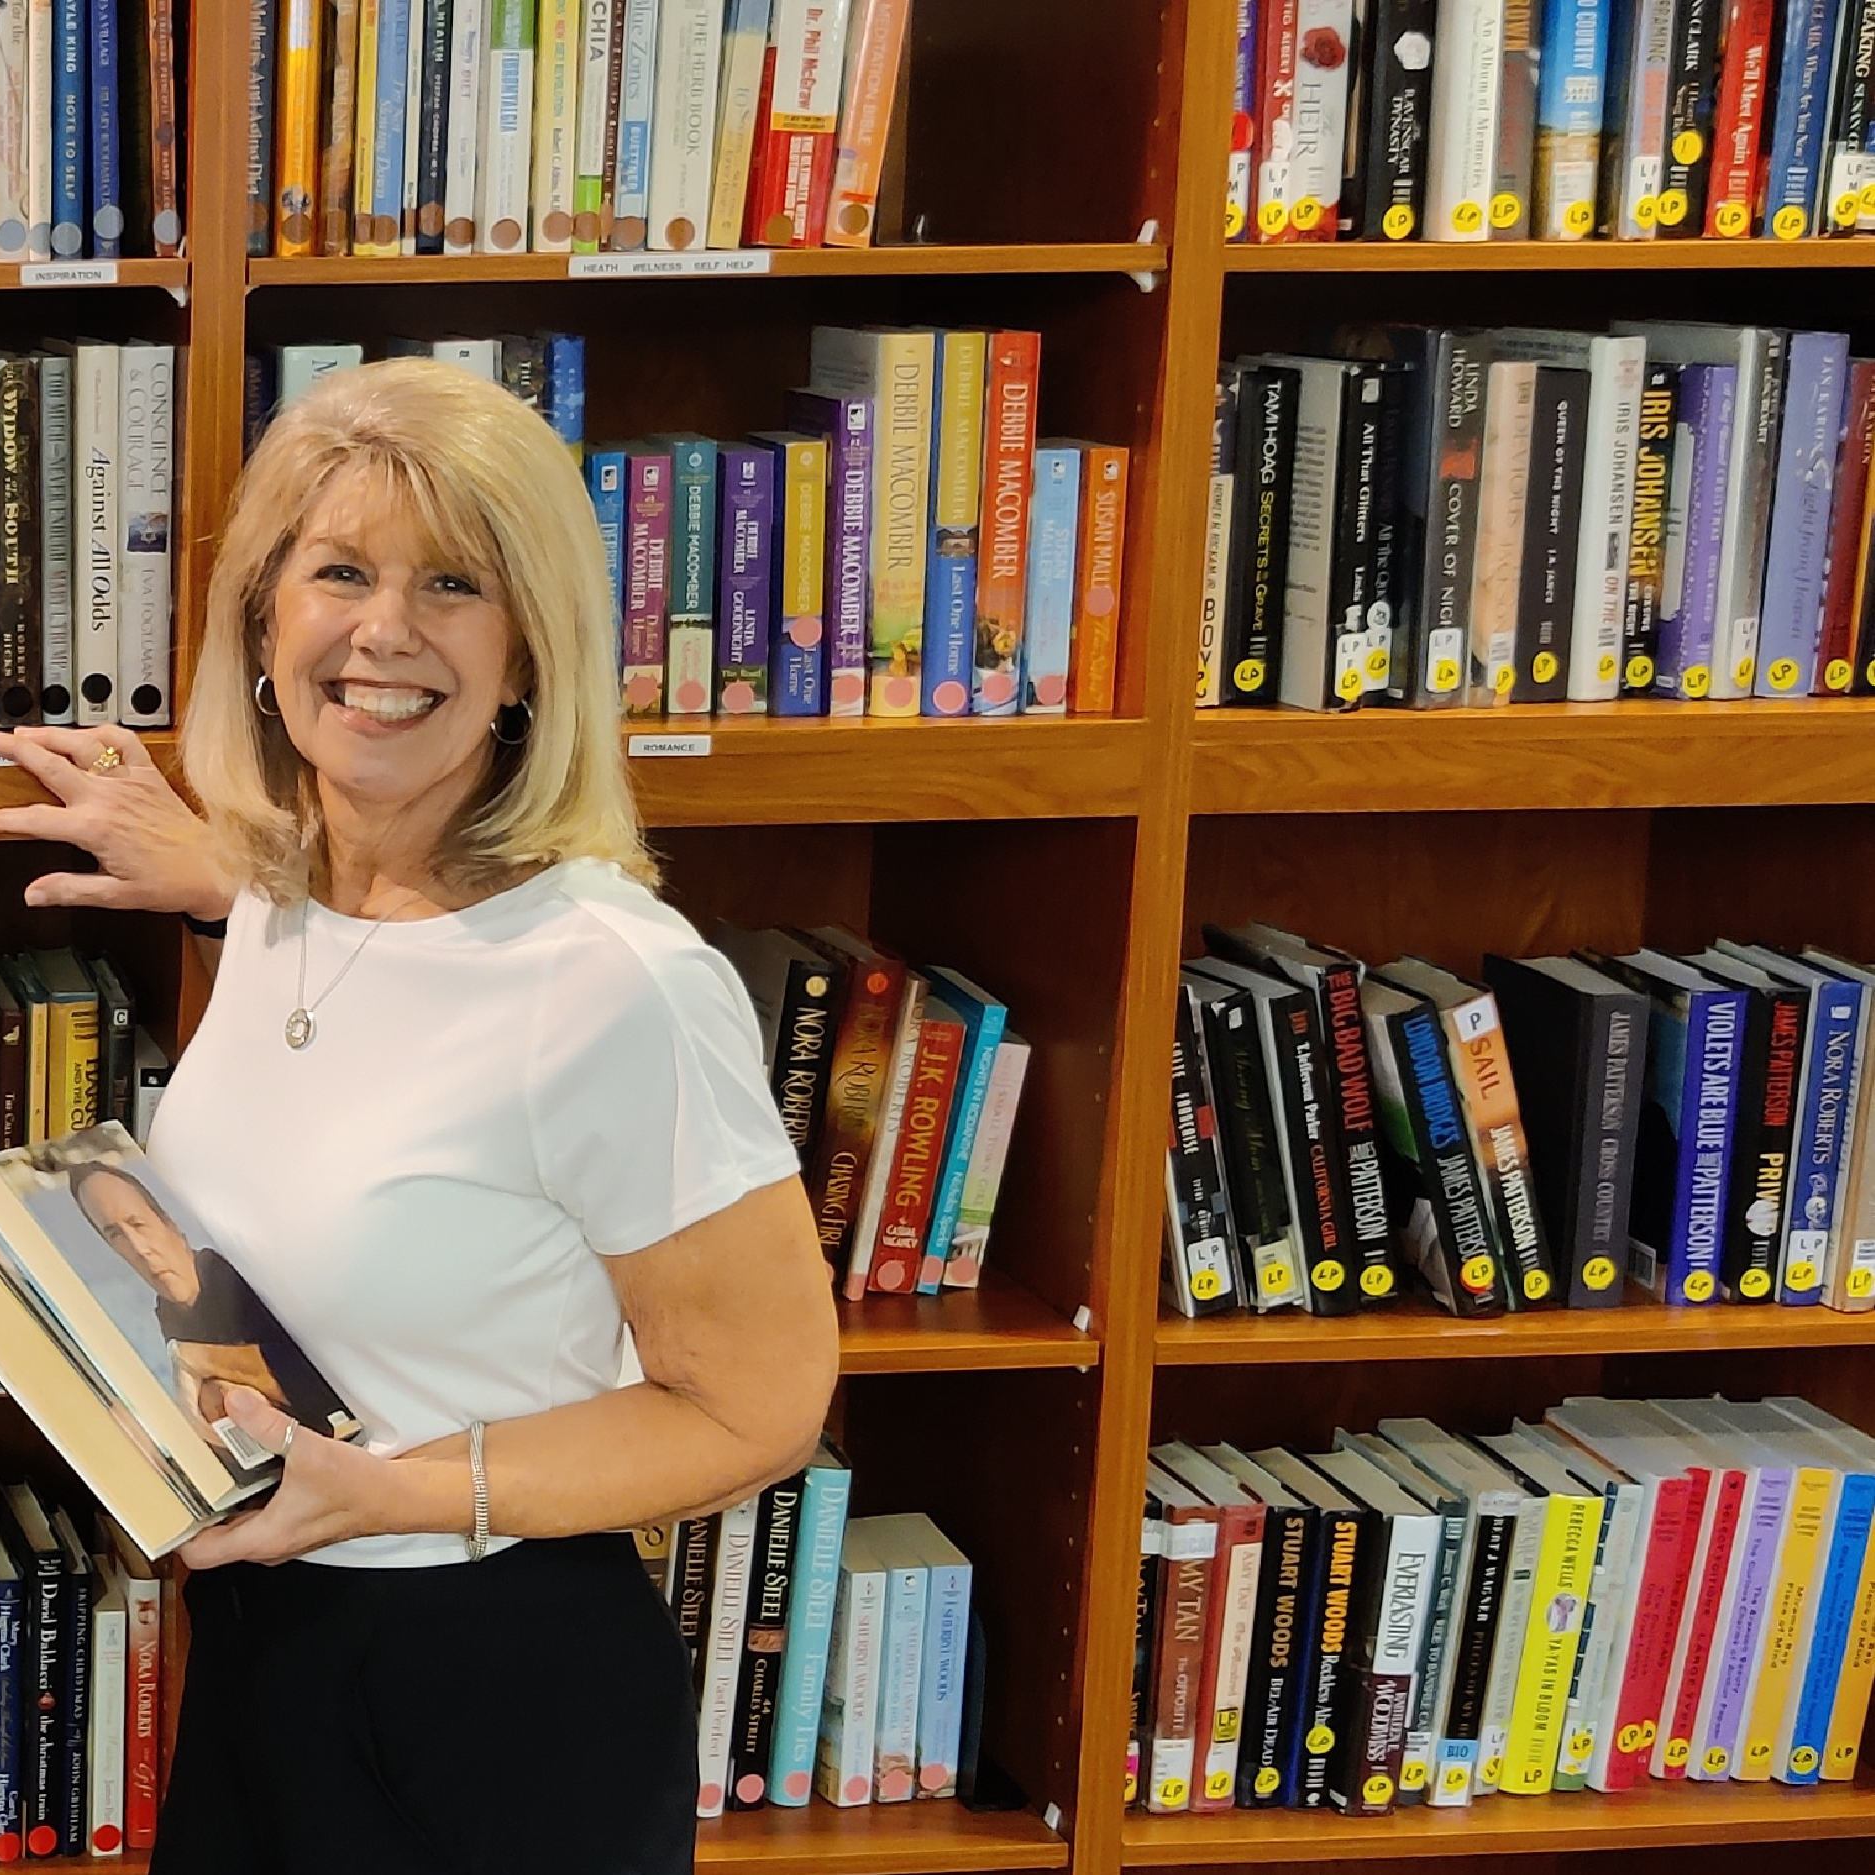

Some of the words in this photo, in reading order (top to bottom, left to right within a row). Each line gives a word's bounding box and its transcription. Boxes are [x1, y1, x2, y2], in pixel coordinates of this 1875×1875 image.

[804, 30, 821, 54] Phil
[806, 8, 822, 25] Dr.
[65, 36, 76, 73] KING
[798, 58, 817, 110] McGraw
[64, 94, 75, 133] NOTE
[1292, 81, 1325, 160] HEIR
[64, 140, 75, 158] TO
[64, 166, 75, 200] SELF
[1718, 209, 1742, 228] LP
[35, 271, 101, 280] INSPIRATION
[583, 263, 618, 272] HEATH
[632, 262, 681, 271] WELNESS
[694, 261, 719, 269] SELF
[726, 261, 754, 269] HELP
[891, 362, 920, 436] DEBBIE
[1263, 378, 1282, 424] TAMI
[1638, 390, 1671, 441] IRIS
[1259, 426, 1279, 484] HOAG
[85, 446, 111, 532] Against
[842, 470, 864, 531] DEBBIE
[885, 444, 917, 571] MACOMBER
[1443, 482, 1462, 547] COVER
[1628, 445, 1667, 578] JOHANSEN
[91, 538, 110, 571] All
[1254, 491, 1274, 568] SECRETS
[629, 523, 647, 609] MACOMBER
[647, 538, 664, 590] DEBBIE
[838, 535, 862, 636] MACOMBER
[1440, 552, 1456, 578] OF
[91, 576, 111, 631] Odds
[1251, 582, 1268, 631] GRAVE
[1239, 666, 1259, 682] LP
[1535, 659, 1551, 676] LP
[1772, 666, 1791, 682] LP
[642, 743, 696, 752] ROMANCE
[1328, 987, 1360, 1027] BIG
[1333, 1026, 1366, 1074] BAD
[1701, 999, 1736, 1072] VIOLETS
[1821, 1029, 1850, 1084] NORA
[915, 1045, 949, 1092] J.K.
[1467, 1035, 1501, 1102] SAIL
[1699, 1072, 1729, 1107] ARE
[1338, 1073, 1373, 1132] WOLF
[1695, 1106, 1726, 1150] BLUE
[1812, 1086, 1843, 1166] ROBERTS
[893, 1094, 939, 1210] ROWLING
[820, 1150, 858, 1218] CHASING
[1350, 1159, 1386, 1241] PATTERSON
[816, 1217, 846, 1250] FIRE
[1685, 1166, 1721, 1262] PATTERSON
[1589, 1266, 1607, 1277] LP
[765, 1490, 797, 1570] DANIELLE
[1277, 1516, 1304, 1589] STUART
[1328, 1520, 1357, 1586] STUART
[41, 1582, 57, 1624] David
[758, 1571, 788, 1622] STEEL
[1320, 1587, 1349, 1654] WOODS
[1380, 1549, 1426, 1662] EVERLASTING
[1269, 1593, 1295, 1668] WOODS
[39, 1629, 57, 1690] Baldacci
[38, 1714, 52, 1732] the
[37, 1736, 51, 1790] christmas
[1446, 1772, 1463, 1785] LP
[1523, 1767, 1542, 1784] LP
[36, 1793, 48, 1820] train
[1162, 1784, 1183, 1797] LP
